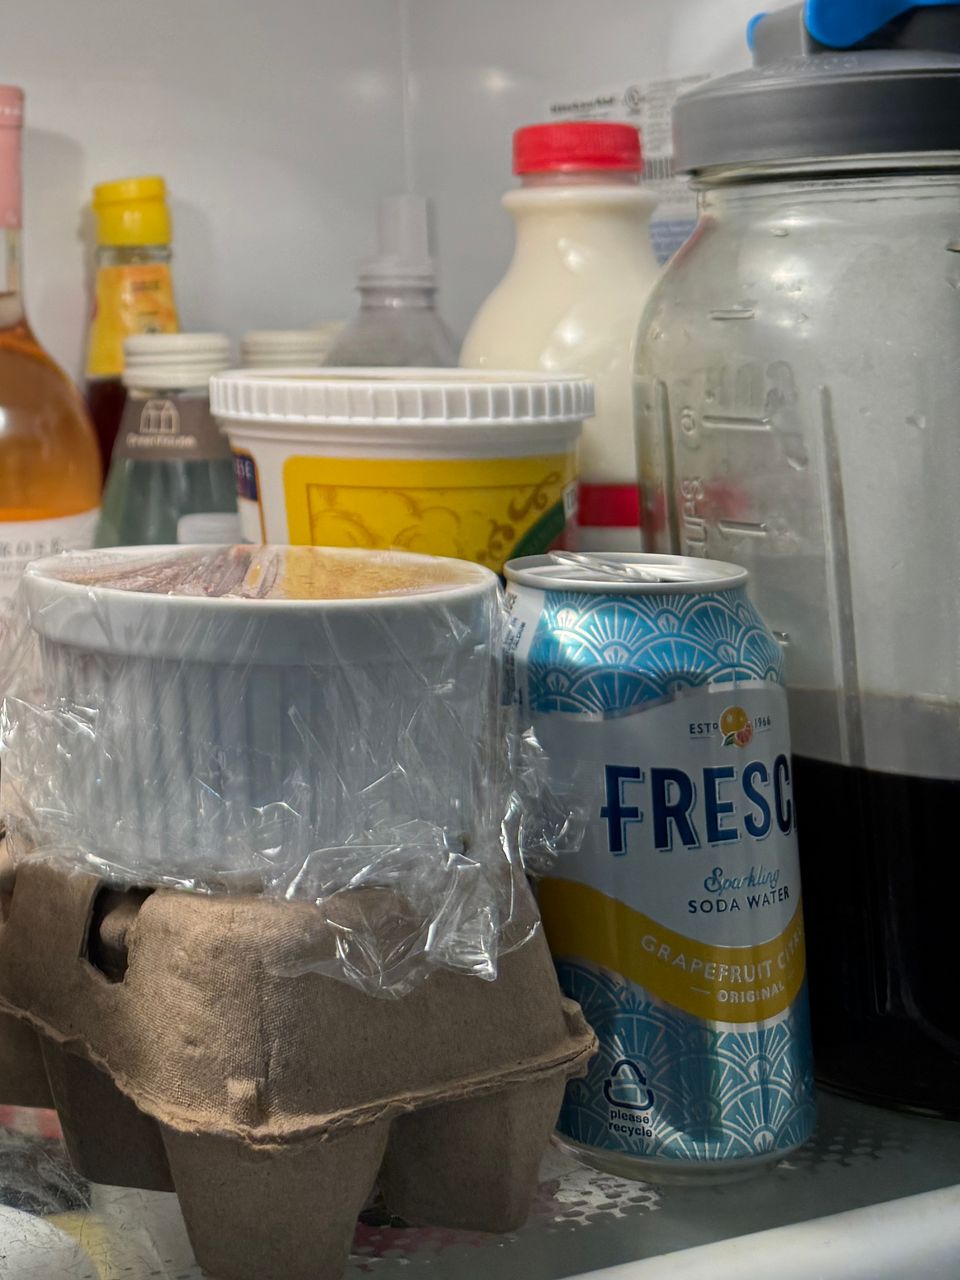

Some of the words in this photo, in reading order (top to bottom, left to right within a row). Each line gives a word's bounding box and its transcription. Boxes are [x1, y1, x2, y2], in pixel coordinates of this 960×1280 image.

[753, 716, 771, 728] 1966
[600, 753, 798, 857] FRESC
[703, 865, 780, 897] Sparkling
[688, 898, 741, 914] SODA
[747, 885, 790, 910] WATER
[640, 934, 773, 984] GRAPEFRUIT
[717, 983, 786, 1005] ORIGINAL
[610, 1108, 650, 1125] please
[608, 1121, 653, 1138] recycle
